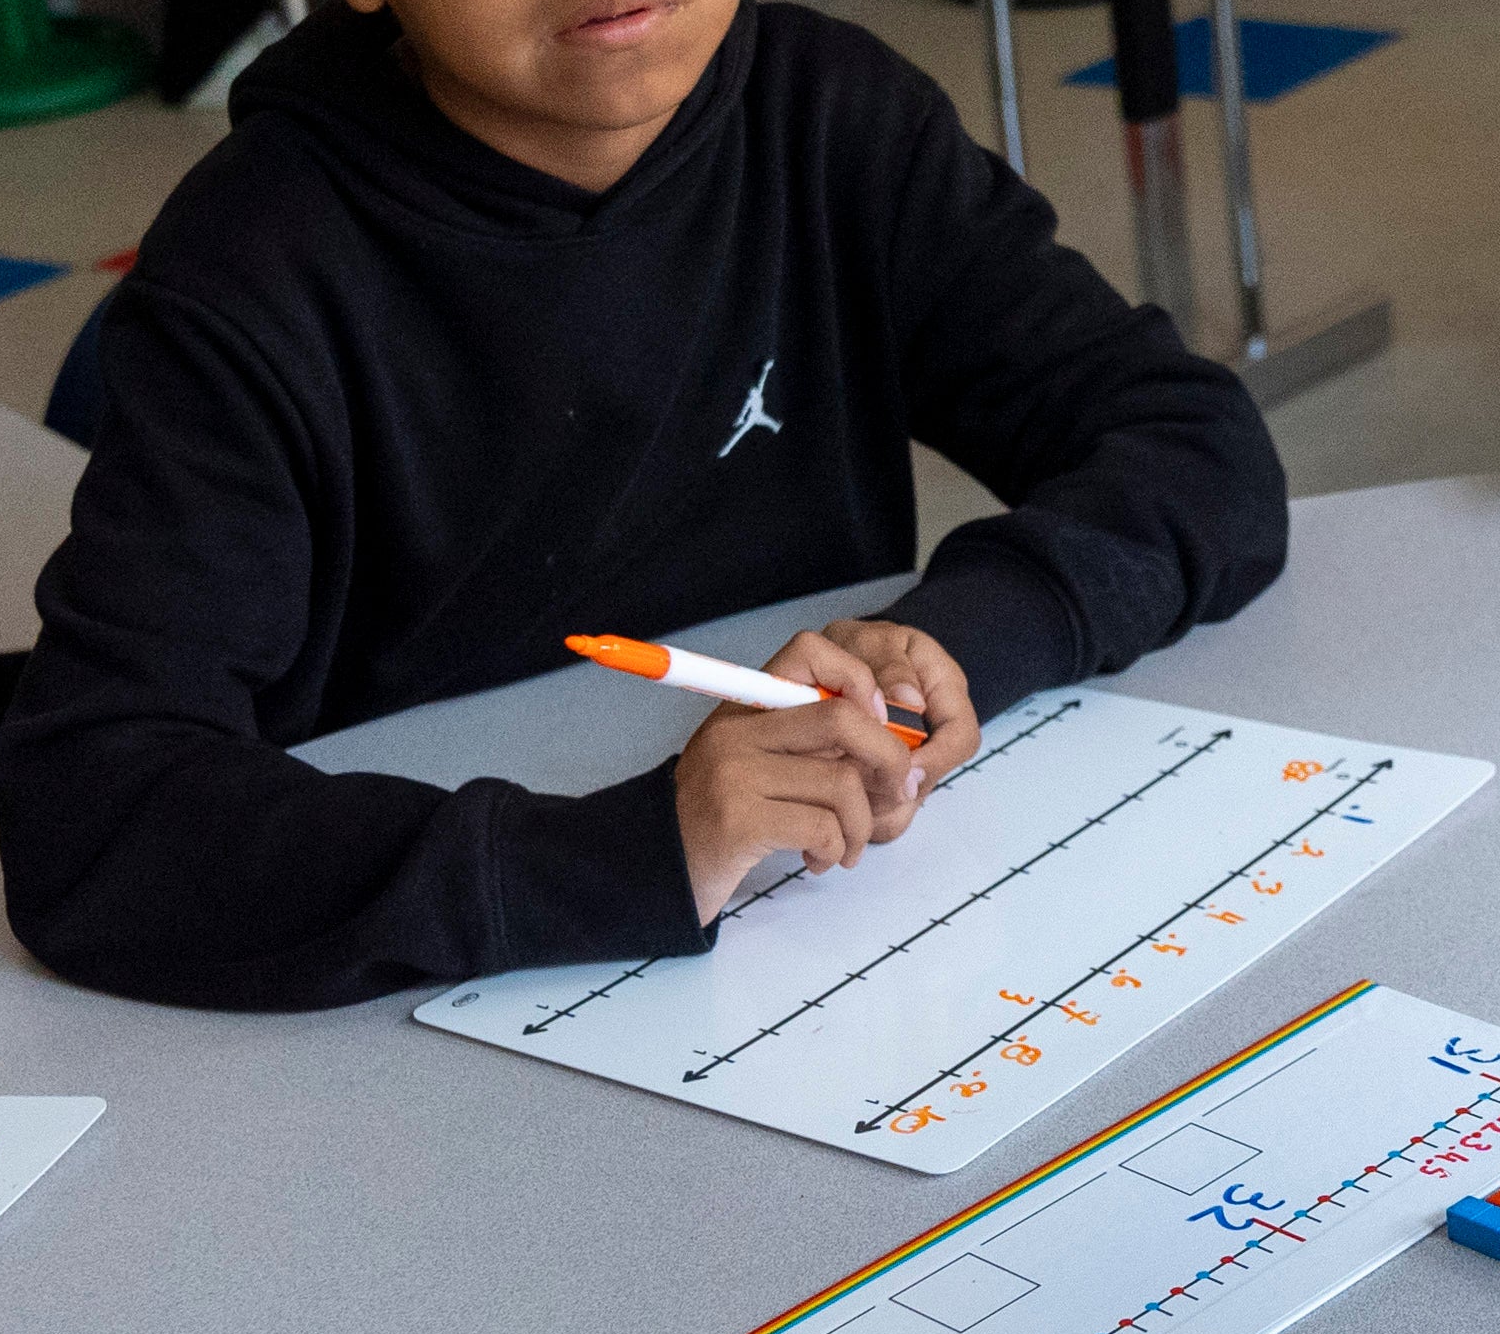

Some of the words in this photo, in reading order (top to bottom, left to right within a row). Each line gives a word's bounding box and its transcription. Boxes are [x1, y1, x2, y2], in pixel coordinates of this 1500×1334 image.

[1251, 871, 1283, 896] .3
[1151, 933, 1187, 957] .5
[1110, 968, 1142, 989] .6
[1000, 1034, 1042, 1066] .8
[1187, 1183, 1287, 1232] 32
